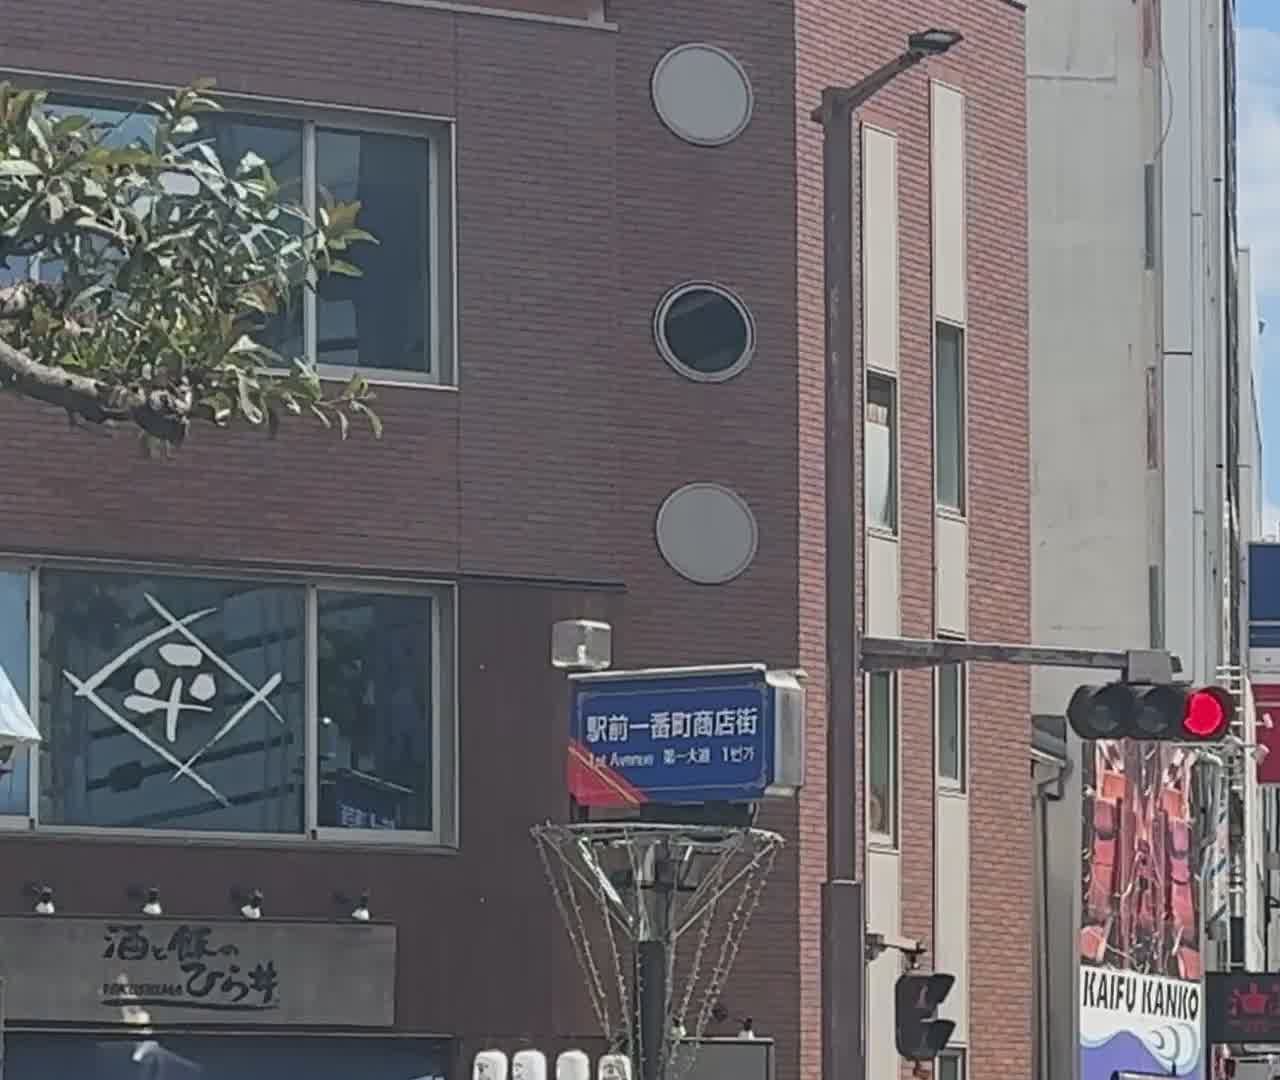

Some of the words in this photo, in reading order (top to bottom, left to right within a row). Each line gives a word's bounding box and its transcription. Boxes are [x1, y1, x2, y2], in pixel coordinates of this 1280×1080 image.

[586, 707, 758, 743] 駅前一番町商店街
[1083, 971, 1136, 1013] KAIFU
[1142, 979, 1199, 1022] KANKO
